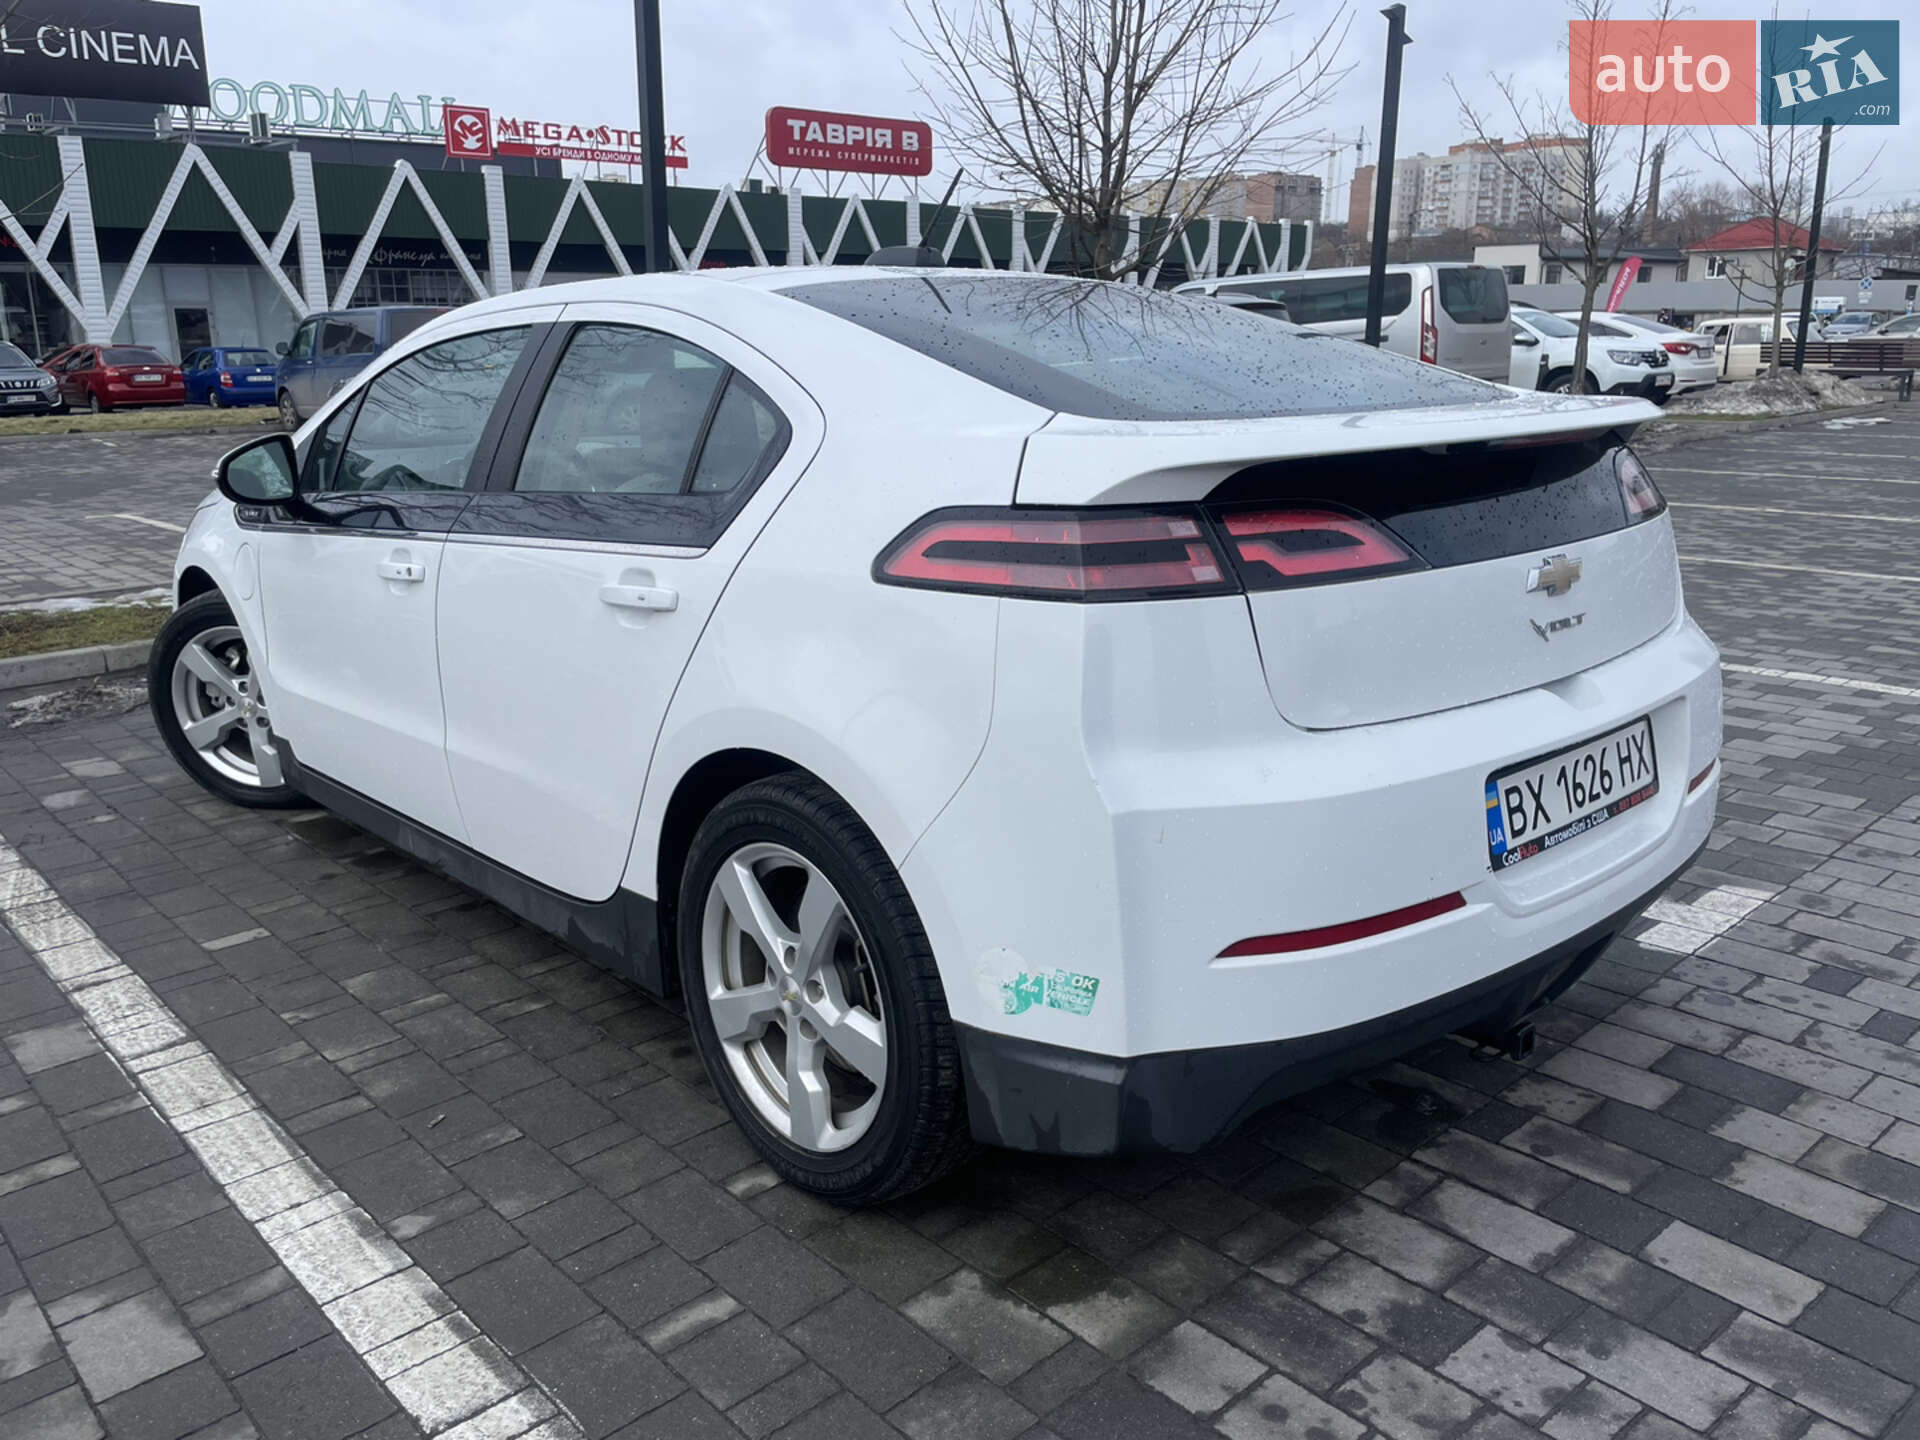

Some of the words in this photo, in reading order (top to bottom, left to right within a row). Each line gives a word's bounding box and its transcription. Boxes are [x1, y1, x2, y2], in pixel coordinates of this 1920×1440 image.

[787, 119, 893, 149] ТАВРІЯ
[902, 130, 920, 152] В
[535, 146, 550, 156] УСІ
[553, 147, 585, 158] БРЕНДИ
[594, 151, 632, 162] ОДНОМУ
[788, 147, 831, 157] МЕРЕЖА
[1529, 612, 1587, 642] VOLT
[1504, 773, 1551, 839] BX
[1556, 747, 1613, 814] 1626
[1616, 730, 1650, 787] HX
[1489, 828, 1504, 846] UA
[1544, 818, 1587, 849] Автомобілі
[1591, 807, 1610, 826] США
